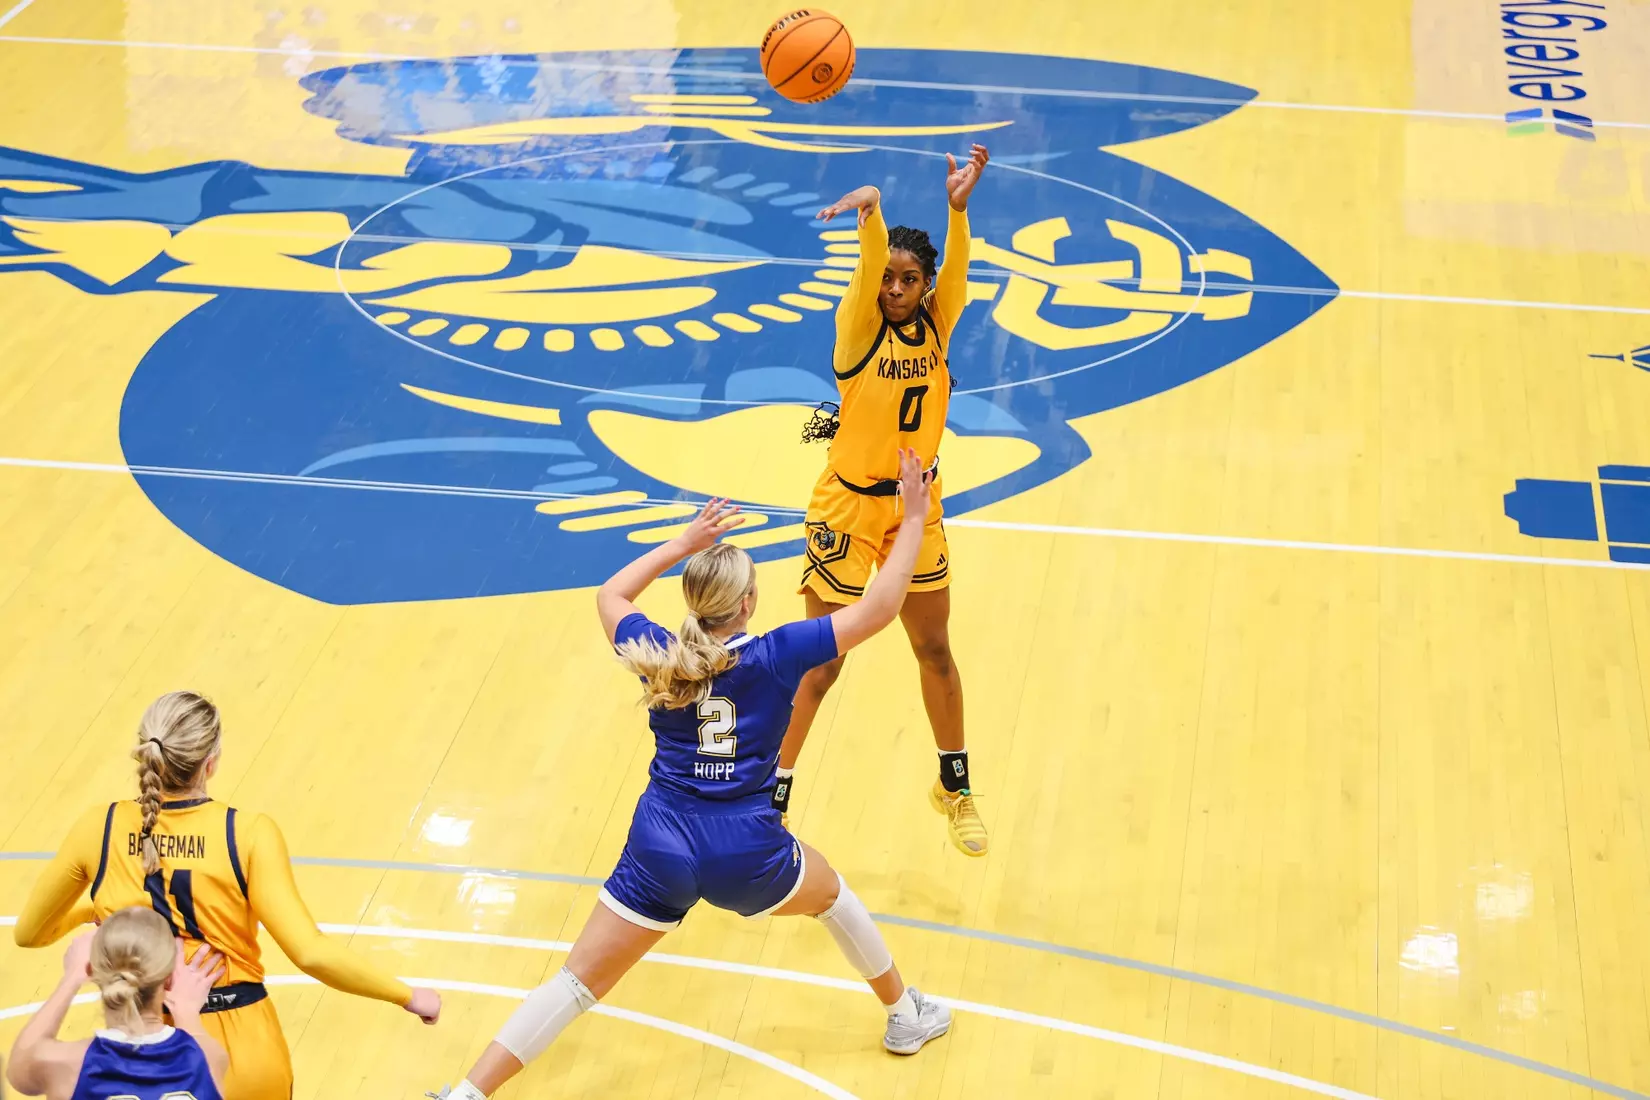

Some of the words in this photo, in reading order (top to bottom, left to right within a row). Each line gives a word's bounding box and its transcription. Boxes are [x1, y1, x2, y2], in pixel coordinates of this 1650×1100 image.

[877, 356, 927, 380] KANSAS
[898, 385, 929, 432] 0
[696, 696, 737, 757] 2
[694, 762, 735, 780] HOPP
[128, 832, 205, 858] BANERMAN
[144, 868, 205, 941] 11
